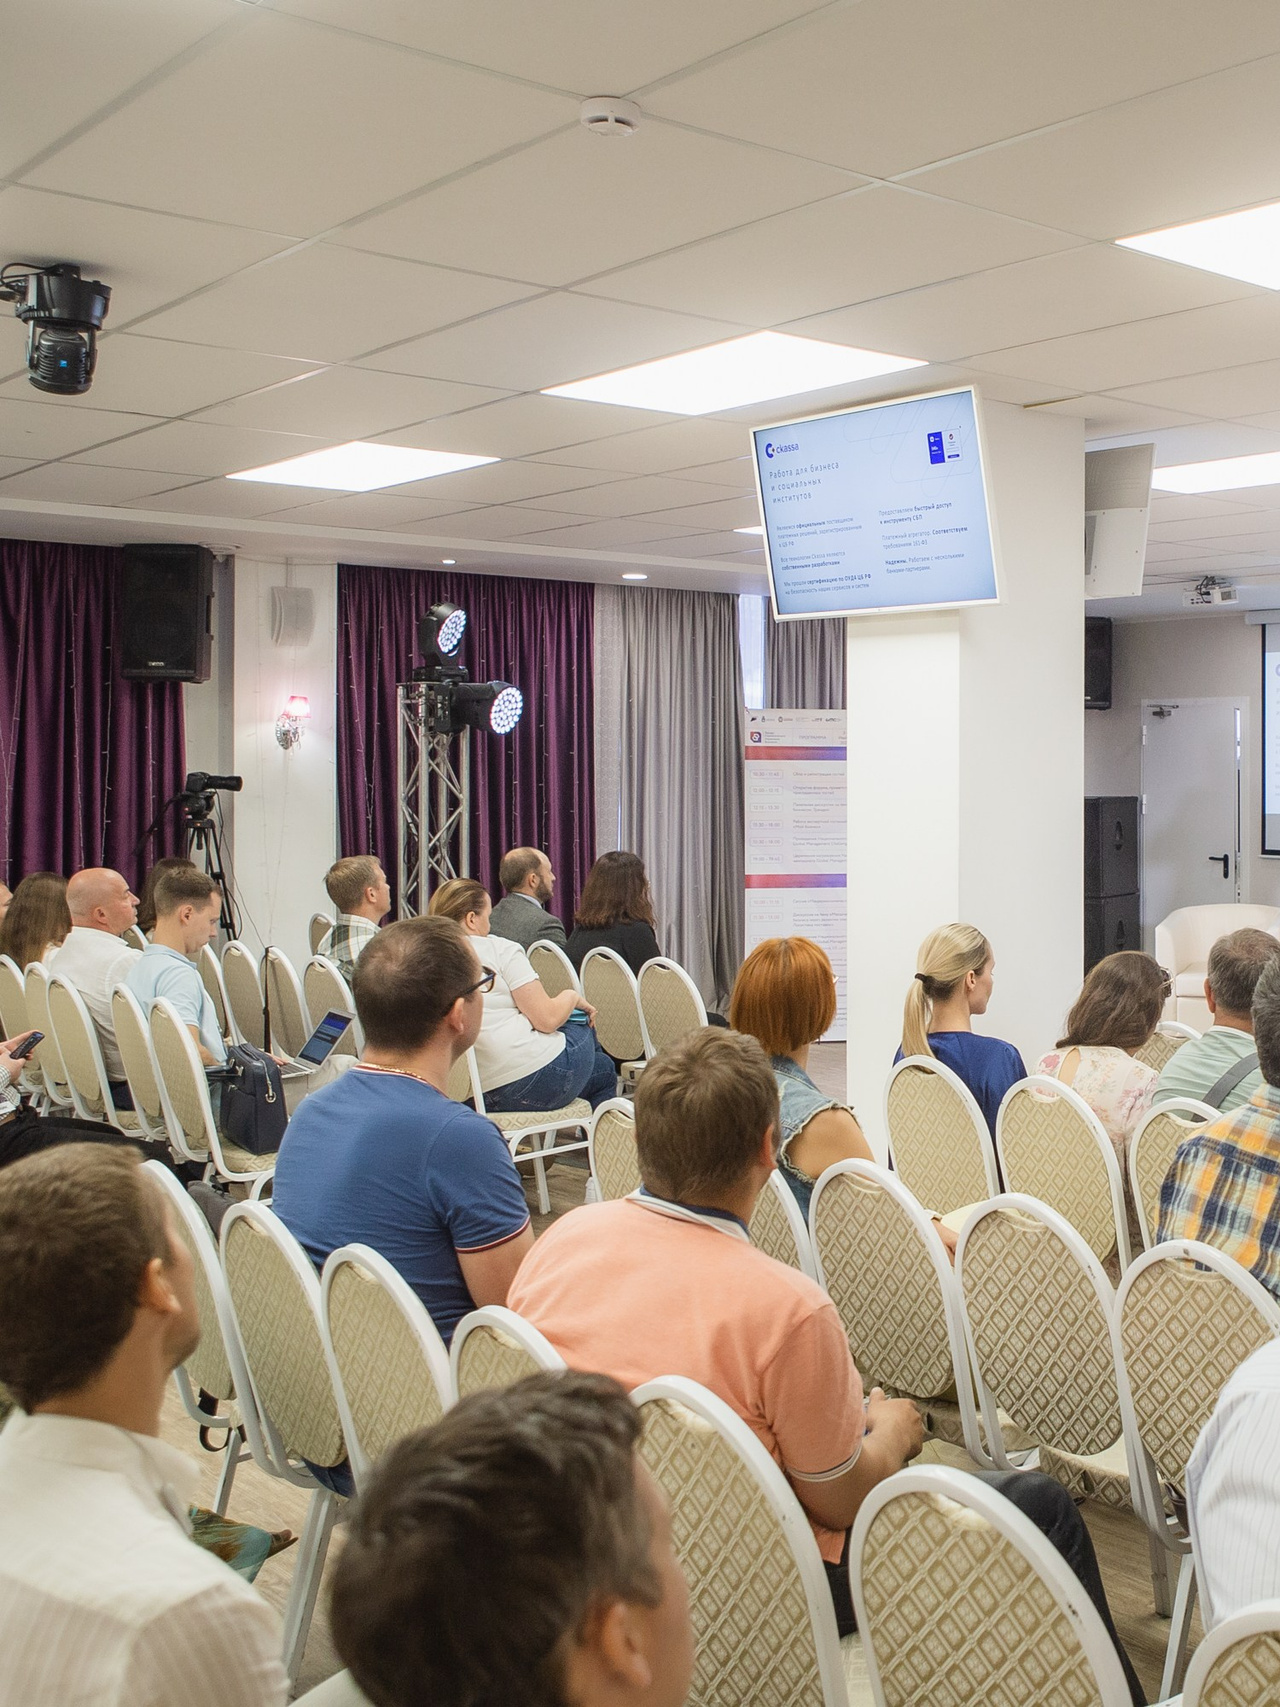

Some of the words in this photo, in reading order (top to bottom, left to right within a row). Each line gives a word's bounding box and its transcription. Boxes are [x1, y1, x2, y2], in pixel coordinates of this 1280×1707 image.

[776, 443, 799, 453] ckassa
[769, 469, 793, 479] Работа
[796, 467, 808, 476] для
[810, 462, 839, 472] бизнеса
[778, 479, 822, 490] социальных
[773, 492, 812, 503] институтов
